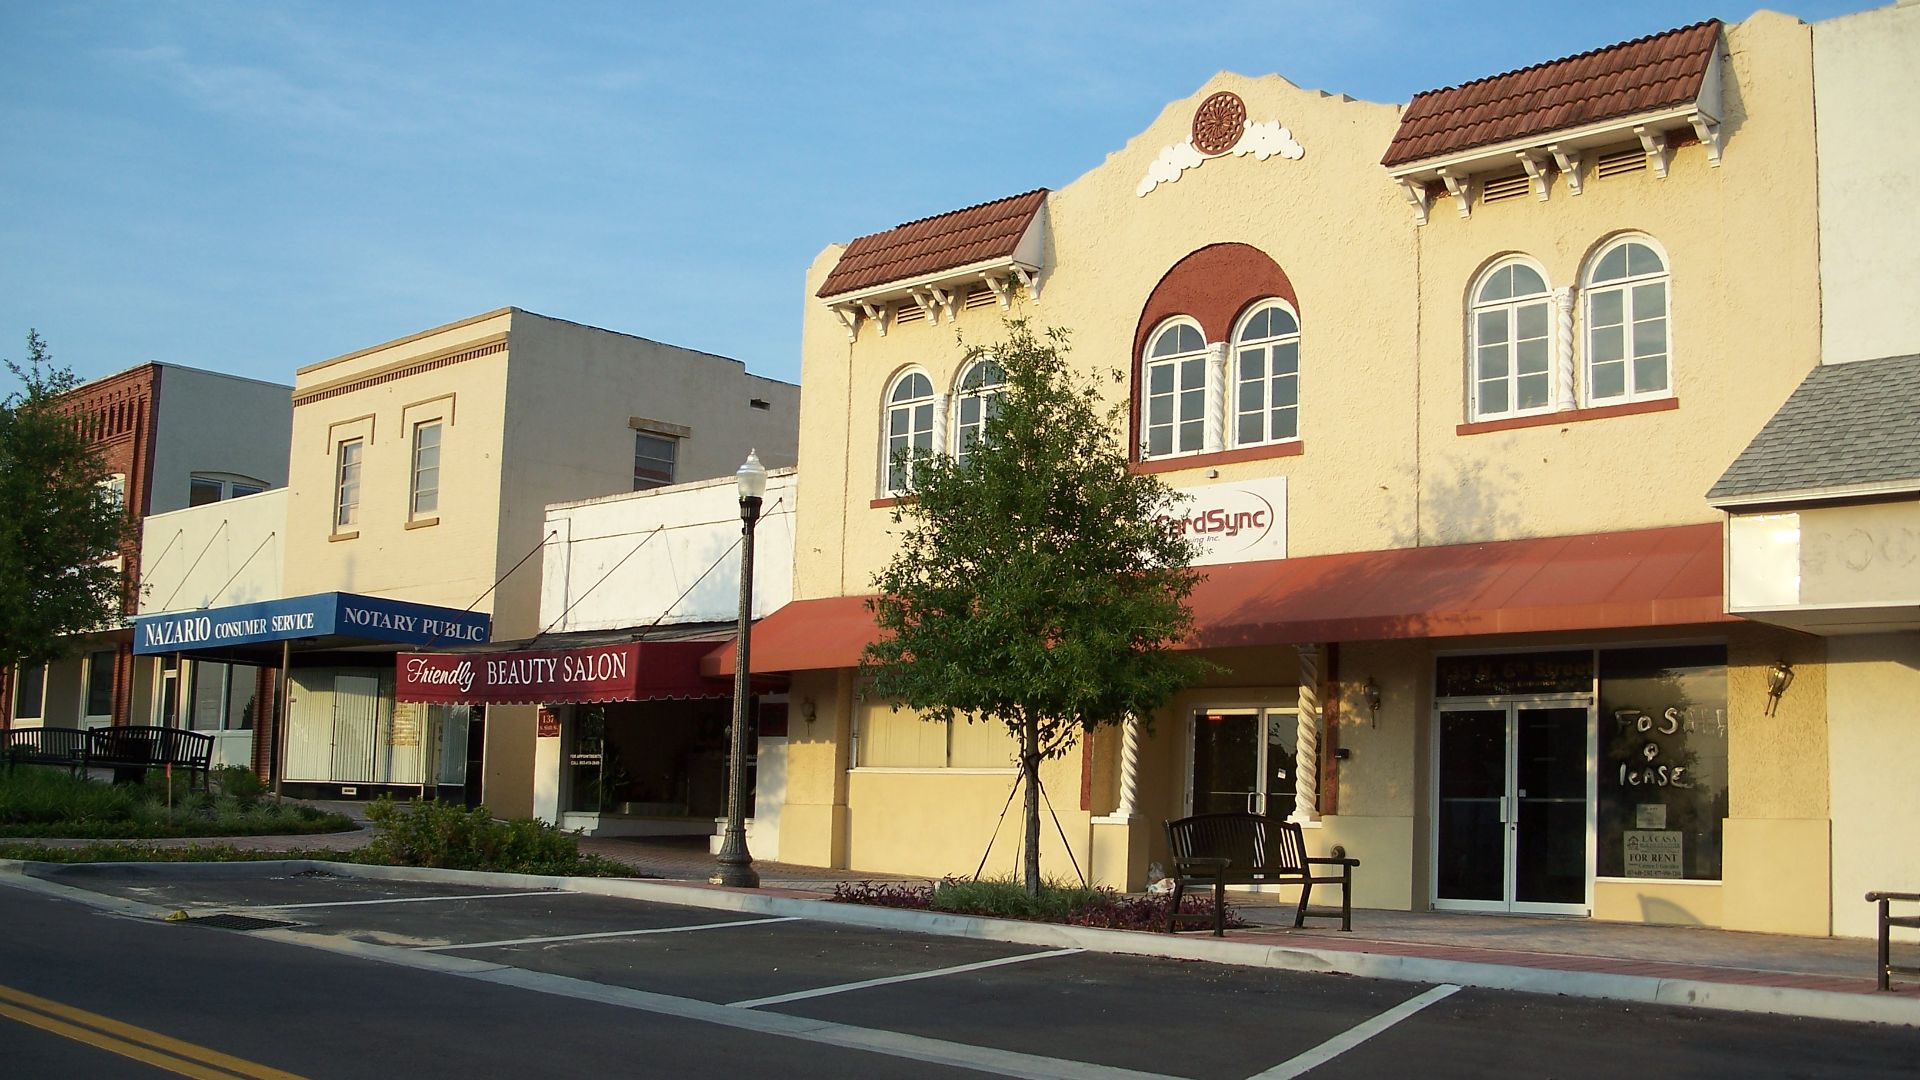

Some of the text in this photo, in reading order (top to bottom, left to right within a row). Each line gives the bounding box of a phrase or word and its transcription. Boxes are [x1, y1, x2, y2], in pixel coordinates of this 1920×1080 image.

[145, 612, 314, 647] NAZARIO CONSUMER SERVICE
[344, 607, 485, 642] NOTARY PUBLIC
[406, 652, 628, 693] Friendly BEAUTY SALON
[543, 714, 554, 724] 137
[1629, 853, 1677, 862] FOR RENT
